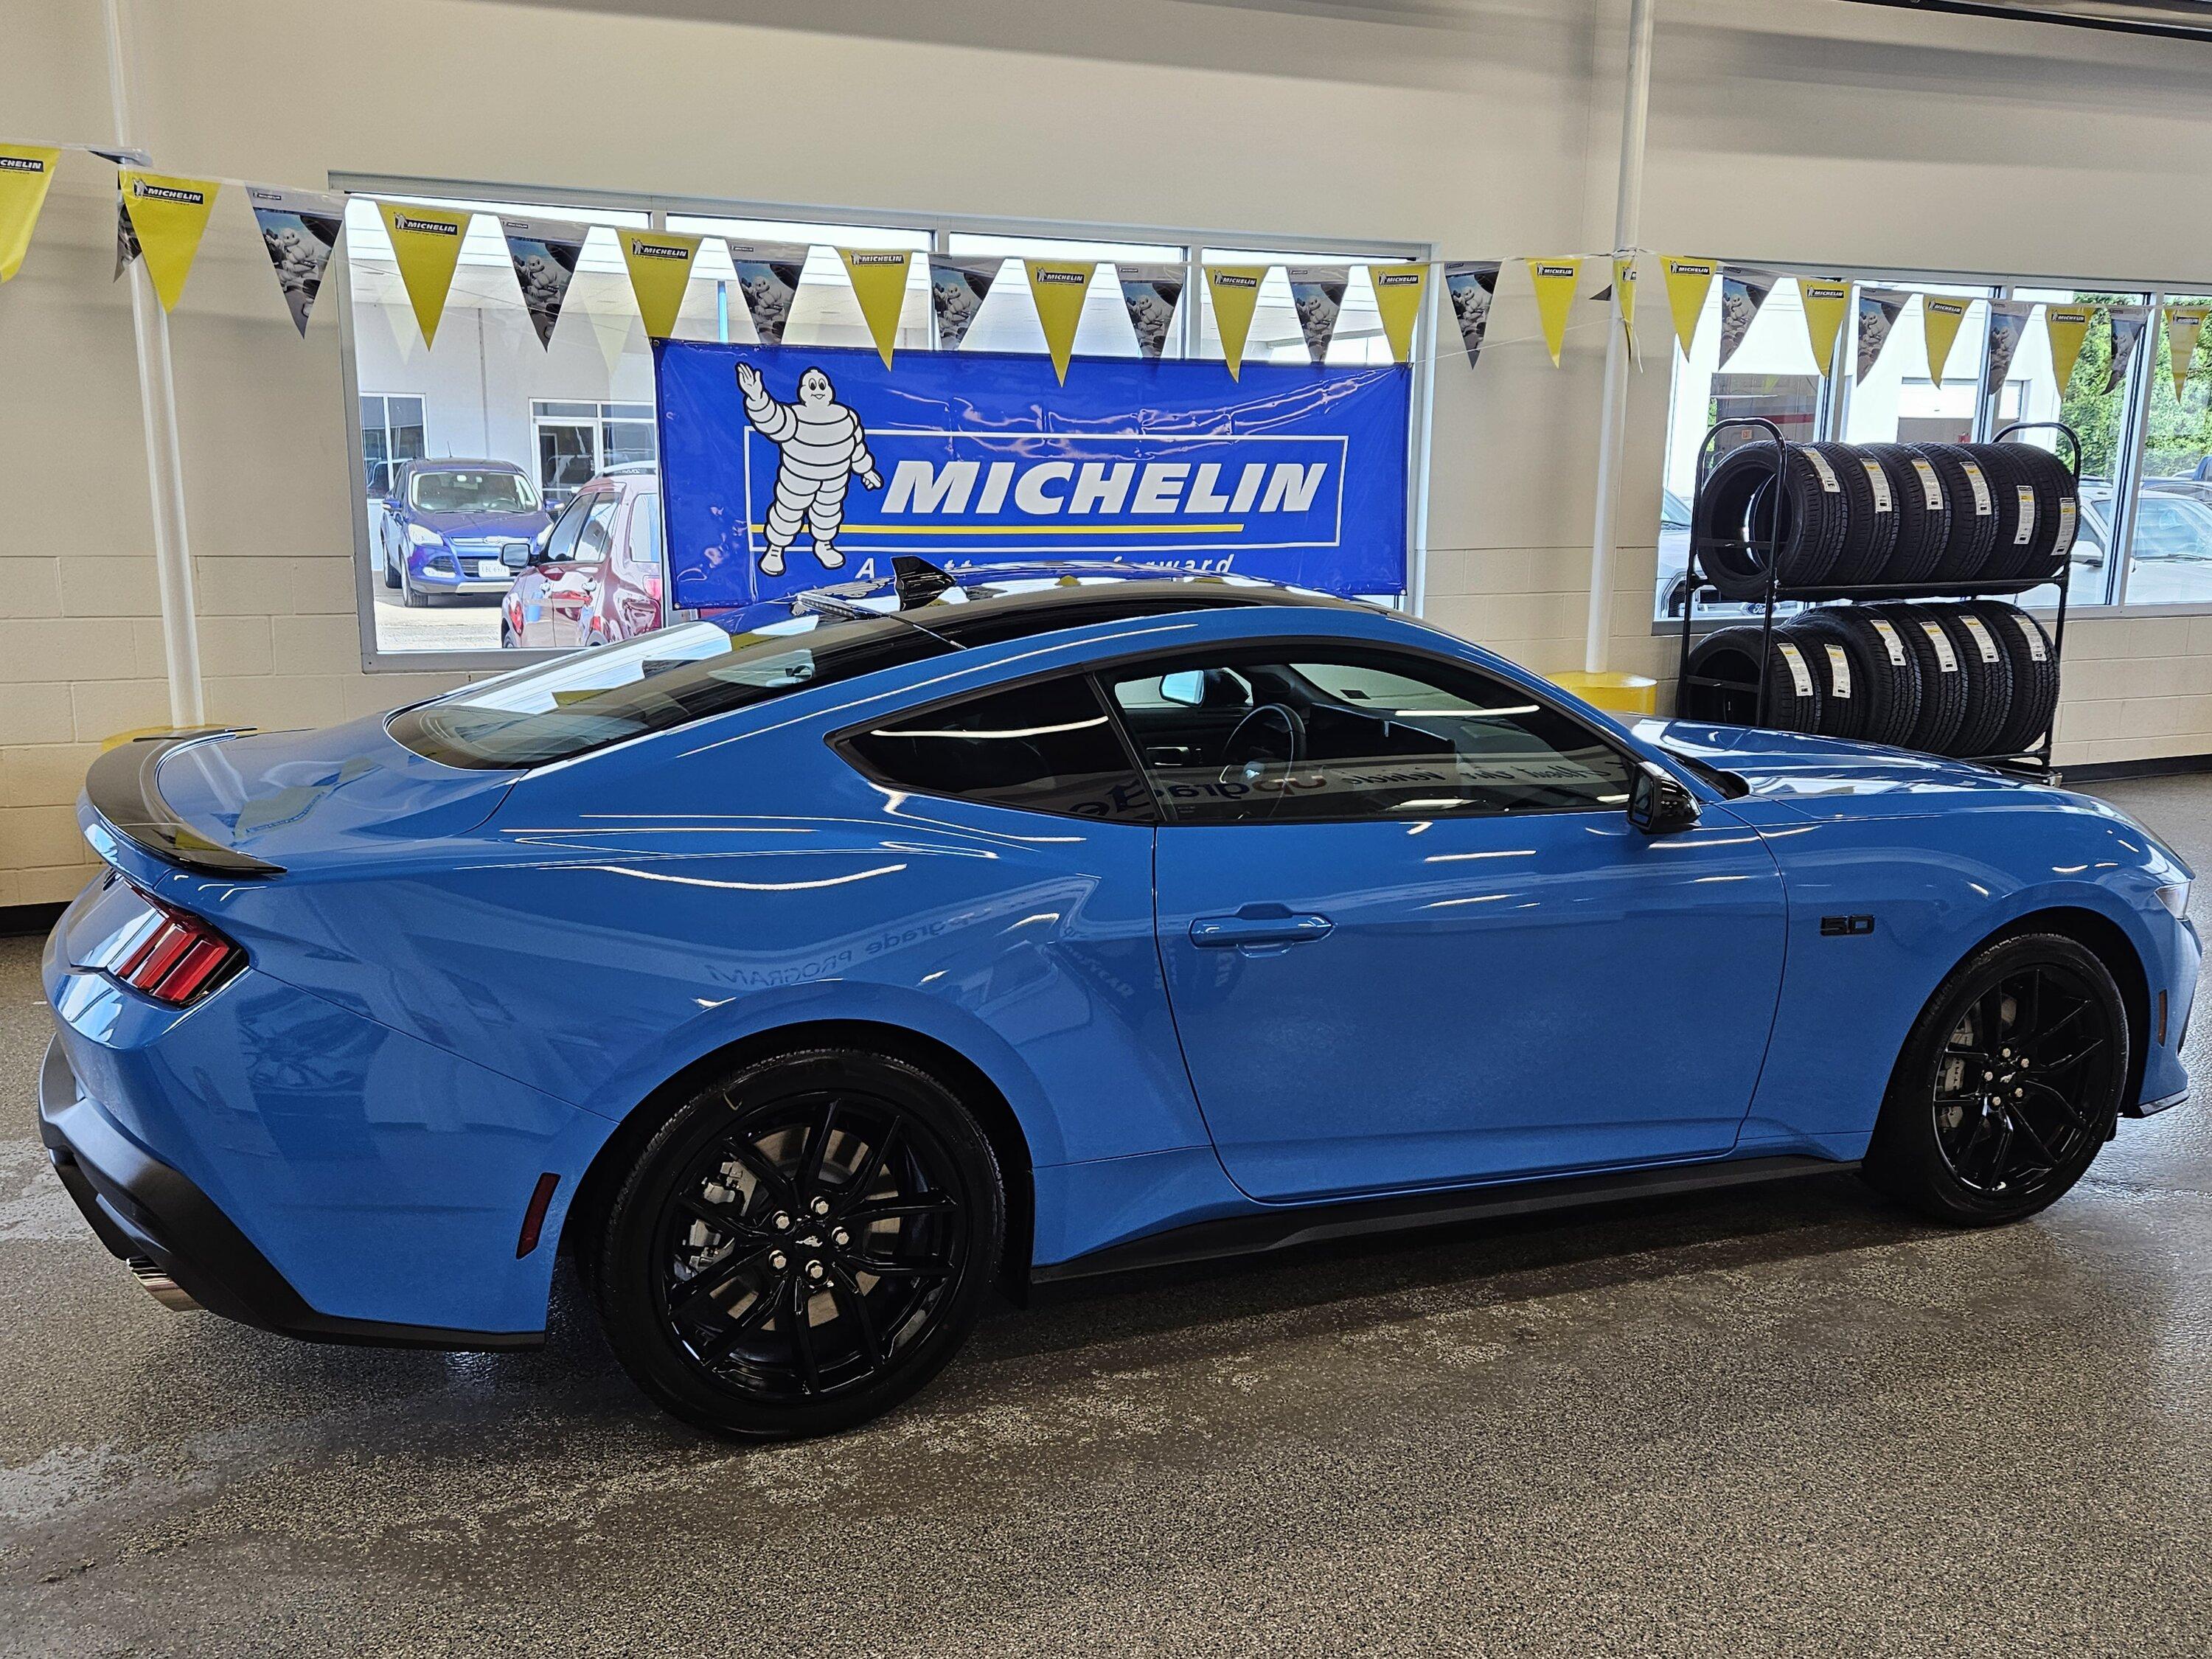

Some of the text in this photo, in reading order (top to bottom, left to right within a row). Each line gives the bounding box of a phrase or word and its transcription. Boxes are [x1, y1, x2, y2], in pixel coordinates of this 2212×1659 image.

[0, 159, 42, 169] CHELIN
[147, 187, 201, 201] MICHELIN
[407, 221, 456, 232] MICHELIN
[643, 247, 686, 257] MICHELIN
[1222, 277, 1256, 285] MICHELIN
[881, 461, 1327, 515] MICHELIN
[855, 557, 875, 579] A
